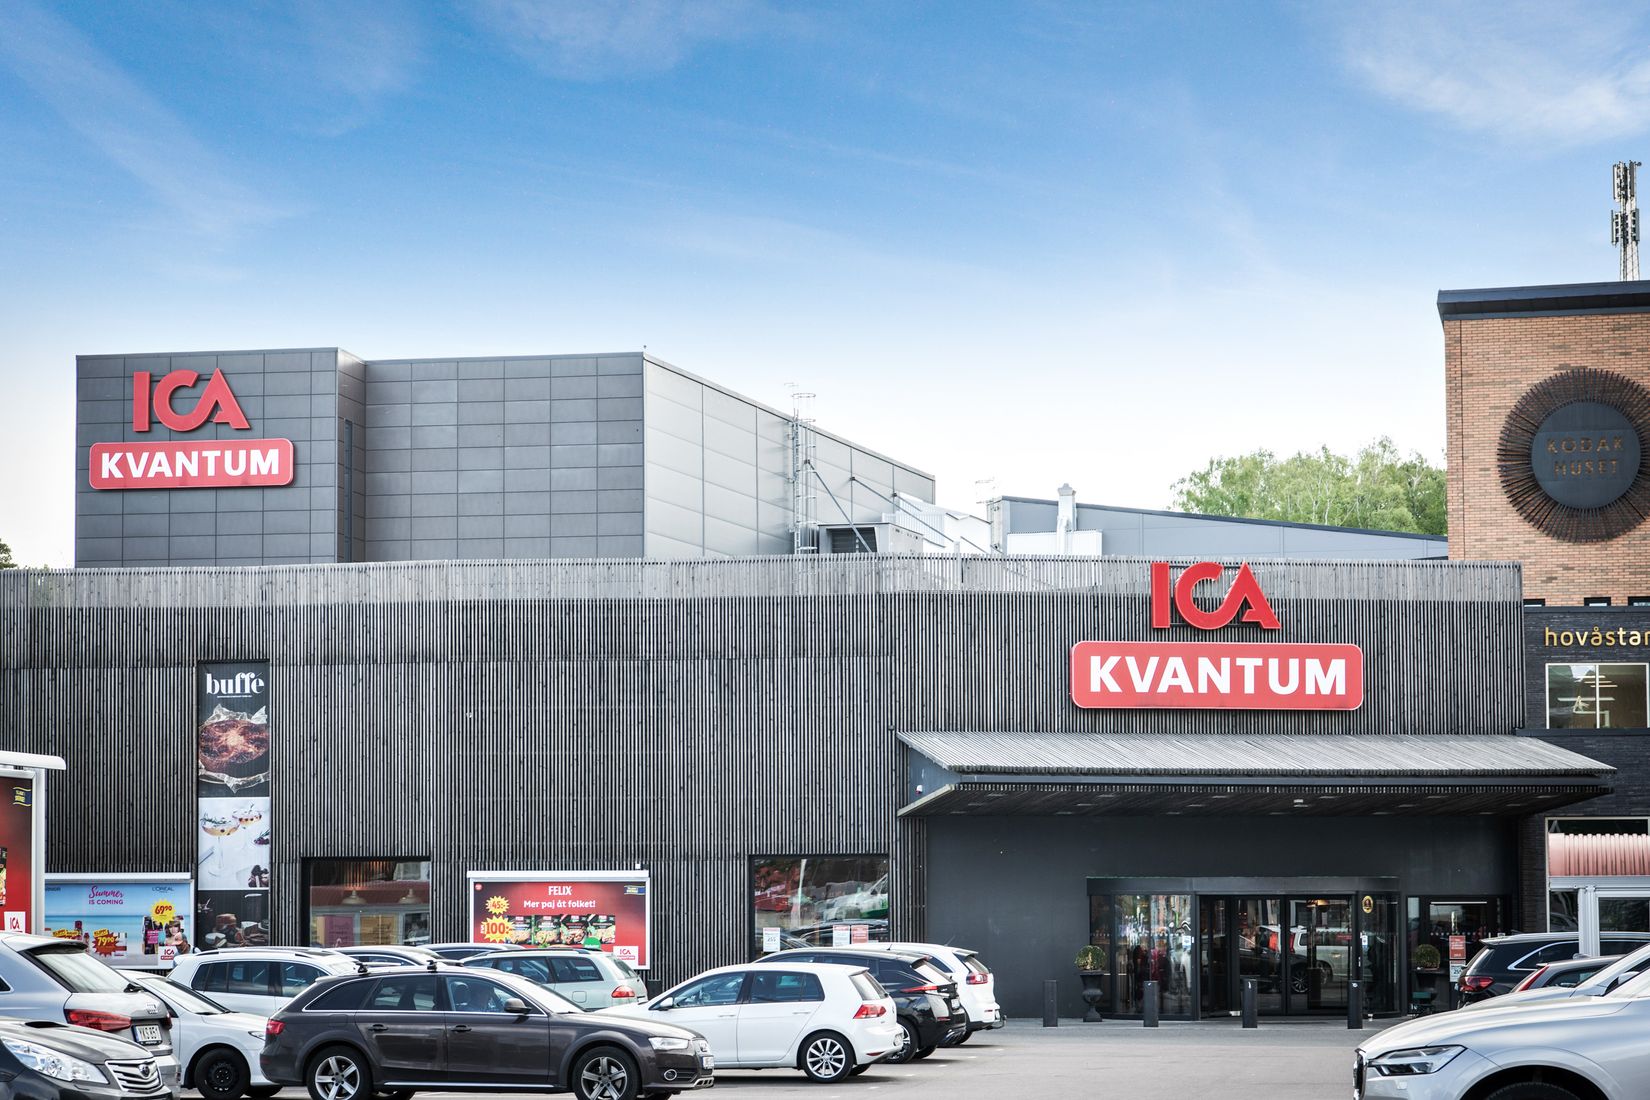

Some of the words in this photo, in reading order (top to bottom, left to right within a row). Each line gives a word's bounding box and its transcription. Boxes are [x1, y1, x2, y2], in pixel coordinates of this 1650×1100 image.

[133, 367, 250, 432] ICA
[1547, 436, 1623, 453] KODAK
[101, 448, 279, 479] KVANTUM
[1151, 560, 1282, 630] ICA
[205, 671, 265, 695] buffé
[1090, 655, 1346, 695] KVANTUM
[88, 885, 124, 898] Summer
[548, 886, 572, 896] FELIX
[523, 900, 540, 908] Mer
[541, 900, 555, 909] paj
[556, 900, 566, 908] åt
[568, 900, 596, 908] folket!
[9, 917, 20, 930] ICA
